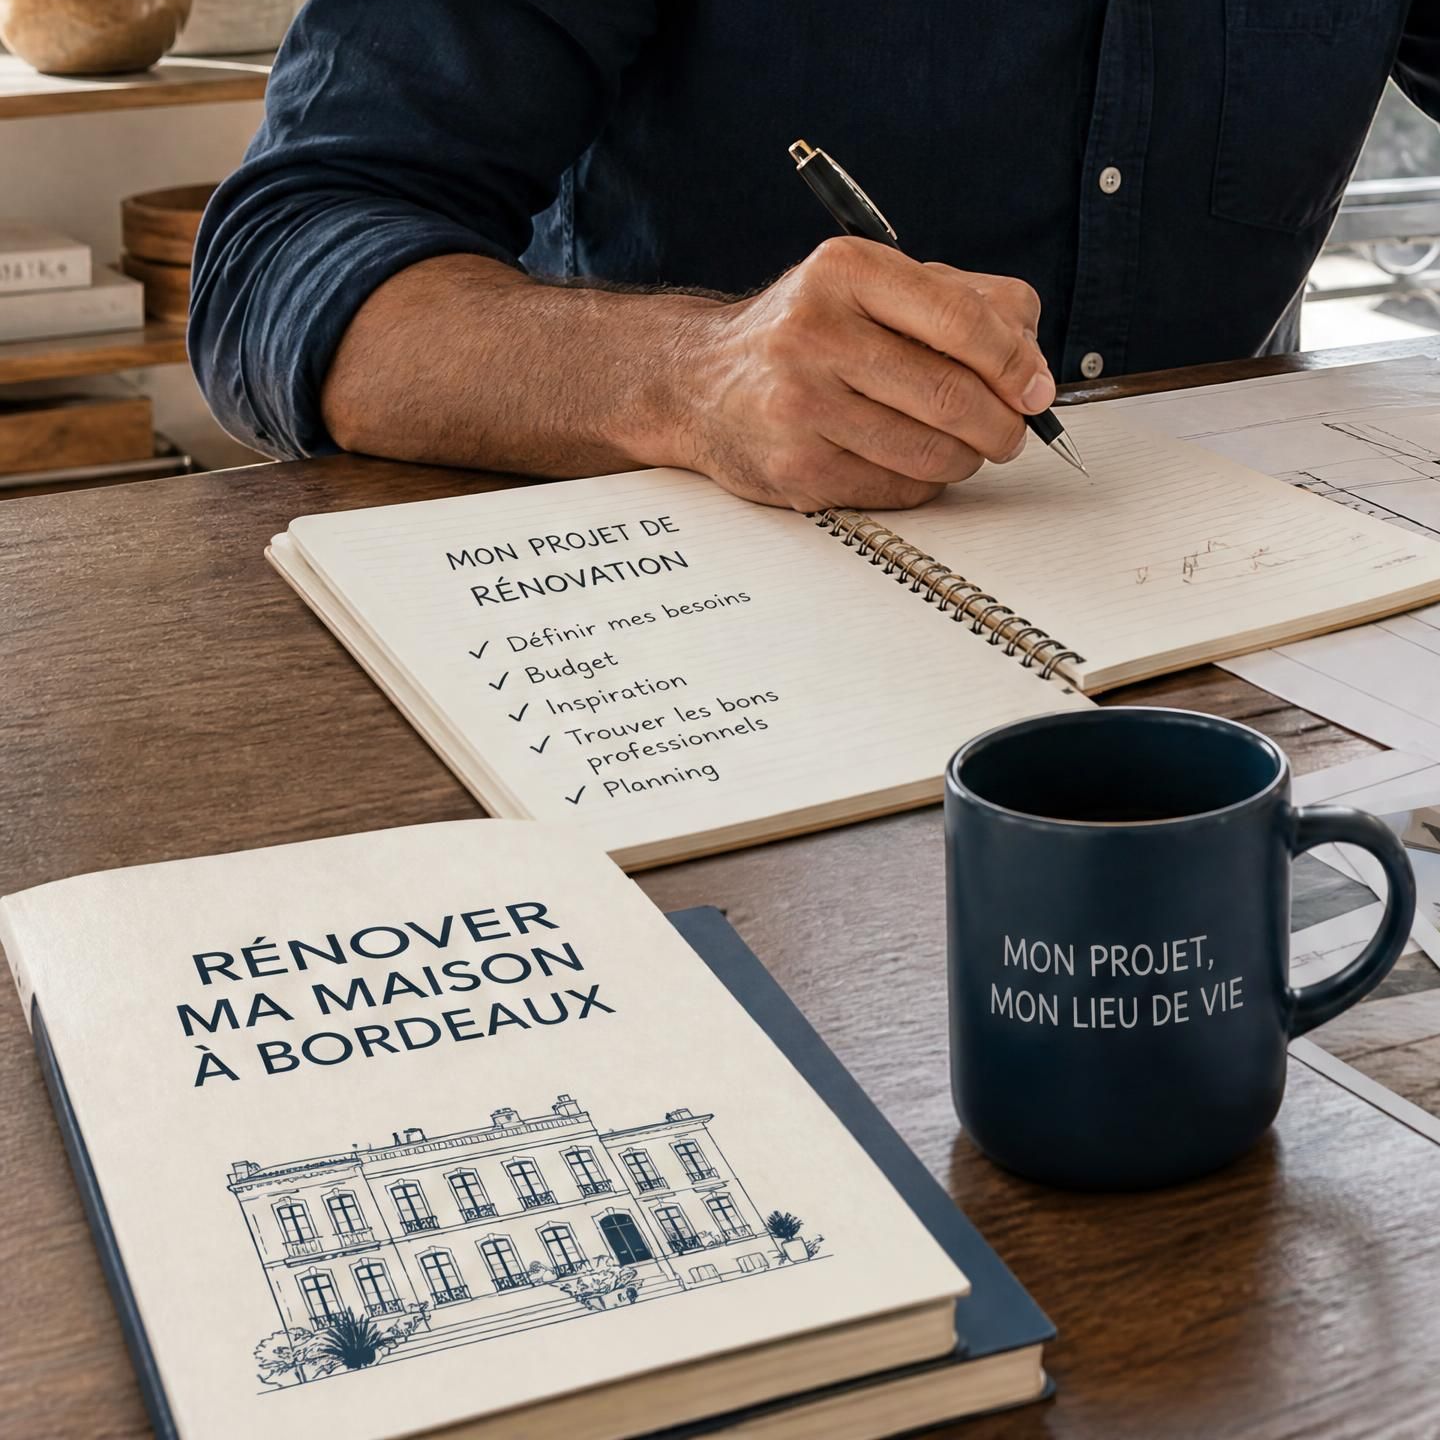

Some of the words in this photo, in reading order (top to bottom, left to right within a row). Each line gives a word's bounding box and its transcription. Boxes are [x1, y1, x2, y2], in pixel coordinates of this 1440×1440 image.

[445, 543, 519, 571] MON
[527, 523, 630, 557] PROJET
[639, 515, 680, 537] DE
[470, 550, 689, 607] RÉNOVATION
[506, 620, 596, 653] Définir
[607, 609, 657, 631] mes
[660, 587, 751, 619] besoins
[524, 651, 619, 684] Budget
[545, 672, 688, 716] Inspiration
[564, 713, 665, 748] Trouver
[673, 703, 712, 722] les
[716, 686, 779, 713] bons
[587, 716, 769, 775] professionnels
[602, 760, 720, 798] Planning
[192, 901, 560, 986] RÉNOVER
[1004, 934, 1075, 976] MON
[1090, 934, 1214, 977] PROJET,
[176, 992, 295, 1037] MA
[311, 942, 585, 1015] MAISON
[990, 982, 1058, 1026] MON
[1073, 996, 1138, 1029] LIEU
[1152, 990, 1190, 1026] DE
[1200, 976, 1244, 1016] VIE
[194, 1044, 241, 1088] À
[256, 984, 617, 1075] BORDEAUX
